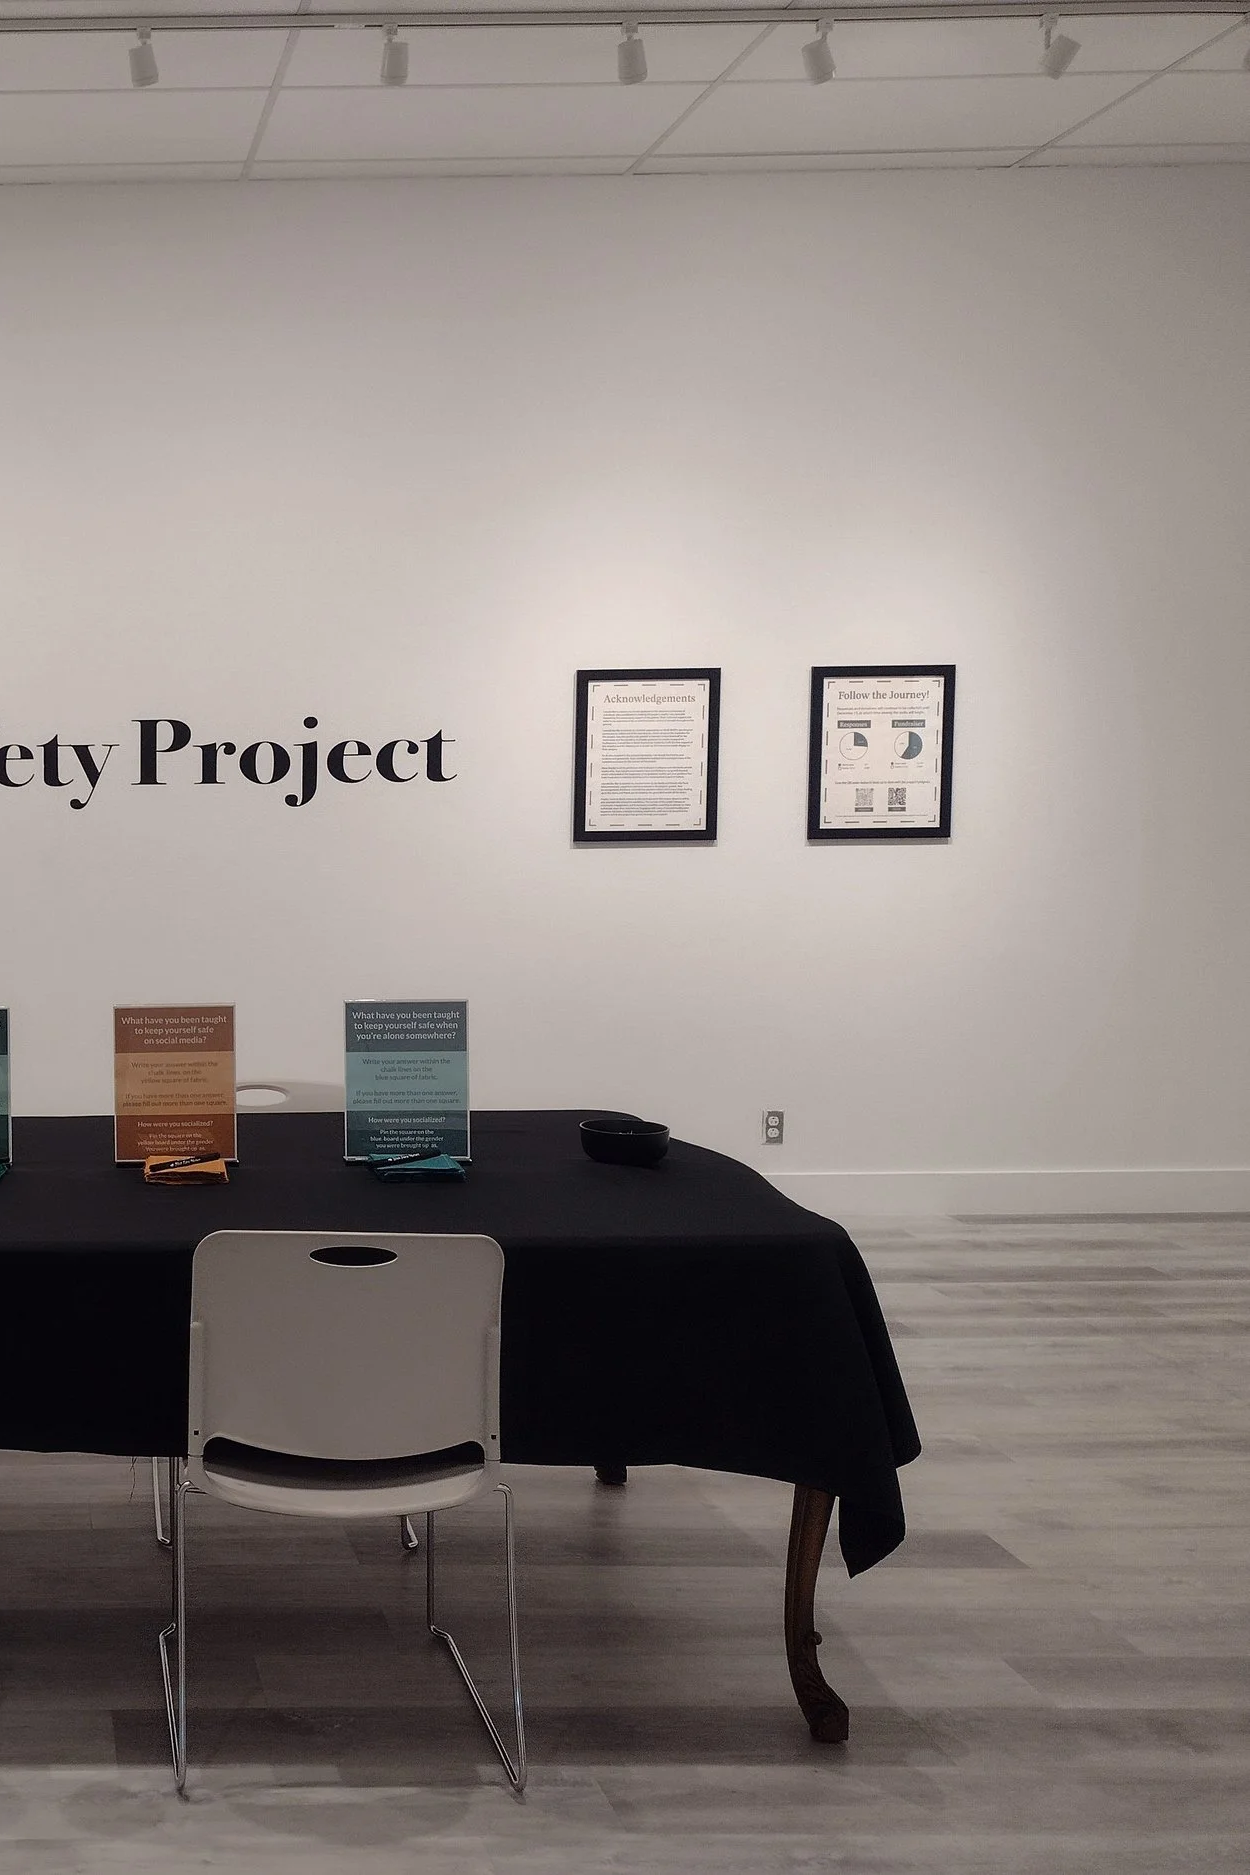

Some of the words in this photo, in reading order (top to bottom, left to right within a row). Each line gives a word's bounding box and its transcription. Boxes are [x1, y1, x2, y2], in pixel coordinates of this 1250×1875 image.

[604, 694, 696, 704] Acknowledgements
[839, 691, 869, 699] Follow
[872, 691, 886, 699] the
[889, 691, 930, 701] Journey!
[131, 716, 458, 808] Project
[352, 1011, 374, 1019] What
[376, 1011, 395, 1019] have
[397, 1012, 411, 1020] you
[413, 1011, 432, 1019] been
[434, 1011, 459, 1020] taught
[166, 1018, 179, 1026] you
[202, 1016, 226, 1025] taught
[364, 1022, 383, 1030] keep
[385, 1022, 417, 1030] yourself
[145, 1027, 164, 1036] keep
[165, 1027, 196, 1036] yourself
[357, 1032, 381, 1040] you're
[156, 1036, 177, 1044] social
[179, 1036, 206, 1044] media?
